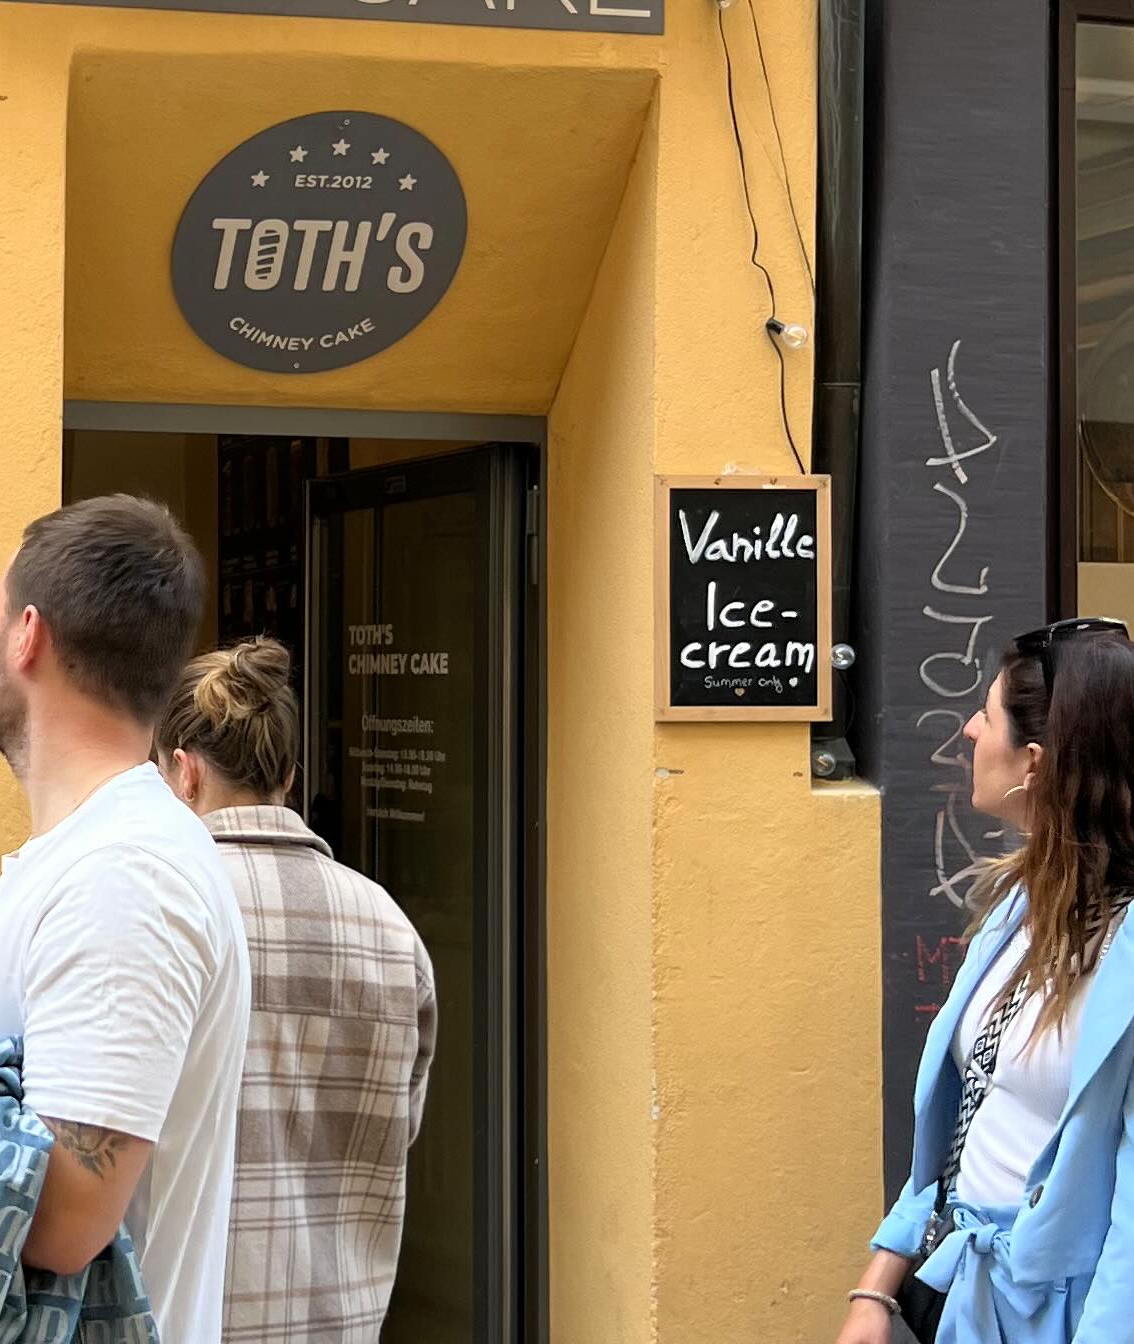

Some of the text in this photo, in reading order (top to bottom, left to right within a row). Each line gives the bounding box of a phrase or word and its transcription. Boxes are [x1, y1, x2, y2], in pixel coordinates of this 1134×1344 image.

[294, 173, 373, 190] EST.2012
[211, 211, 435, 294] TOTH'S
[228, 316, 376, 351] CHIMNEY CAKE
[678, 508, 815, 565] Vanille
[707, 580, 798, 632] Ice-
[348, 623, 394, 645] TOTH'S
[348, 652, 449, 675] CHIMNEY CAKE
[679, 640, 815, 674] cream
[703, 674, 785, 694] Summer only
